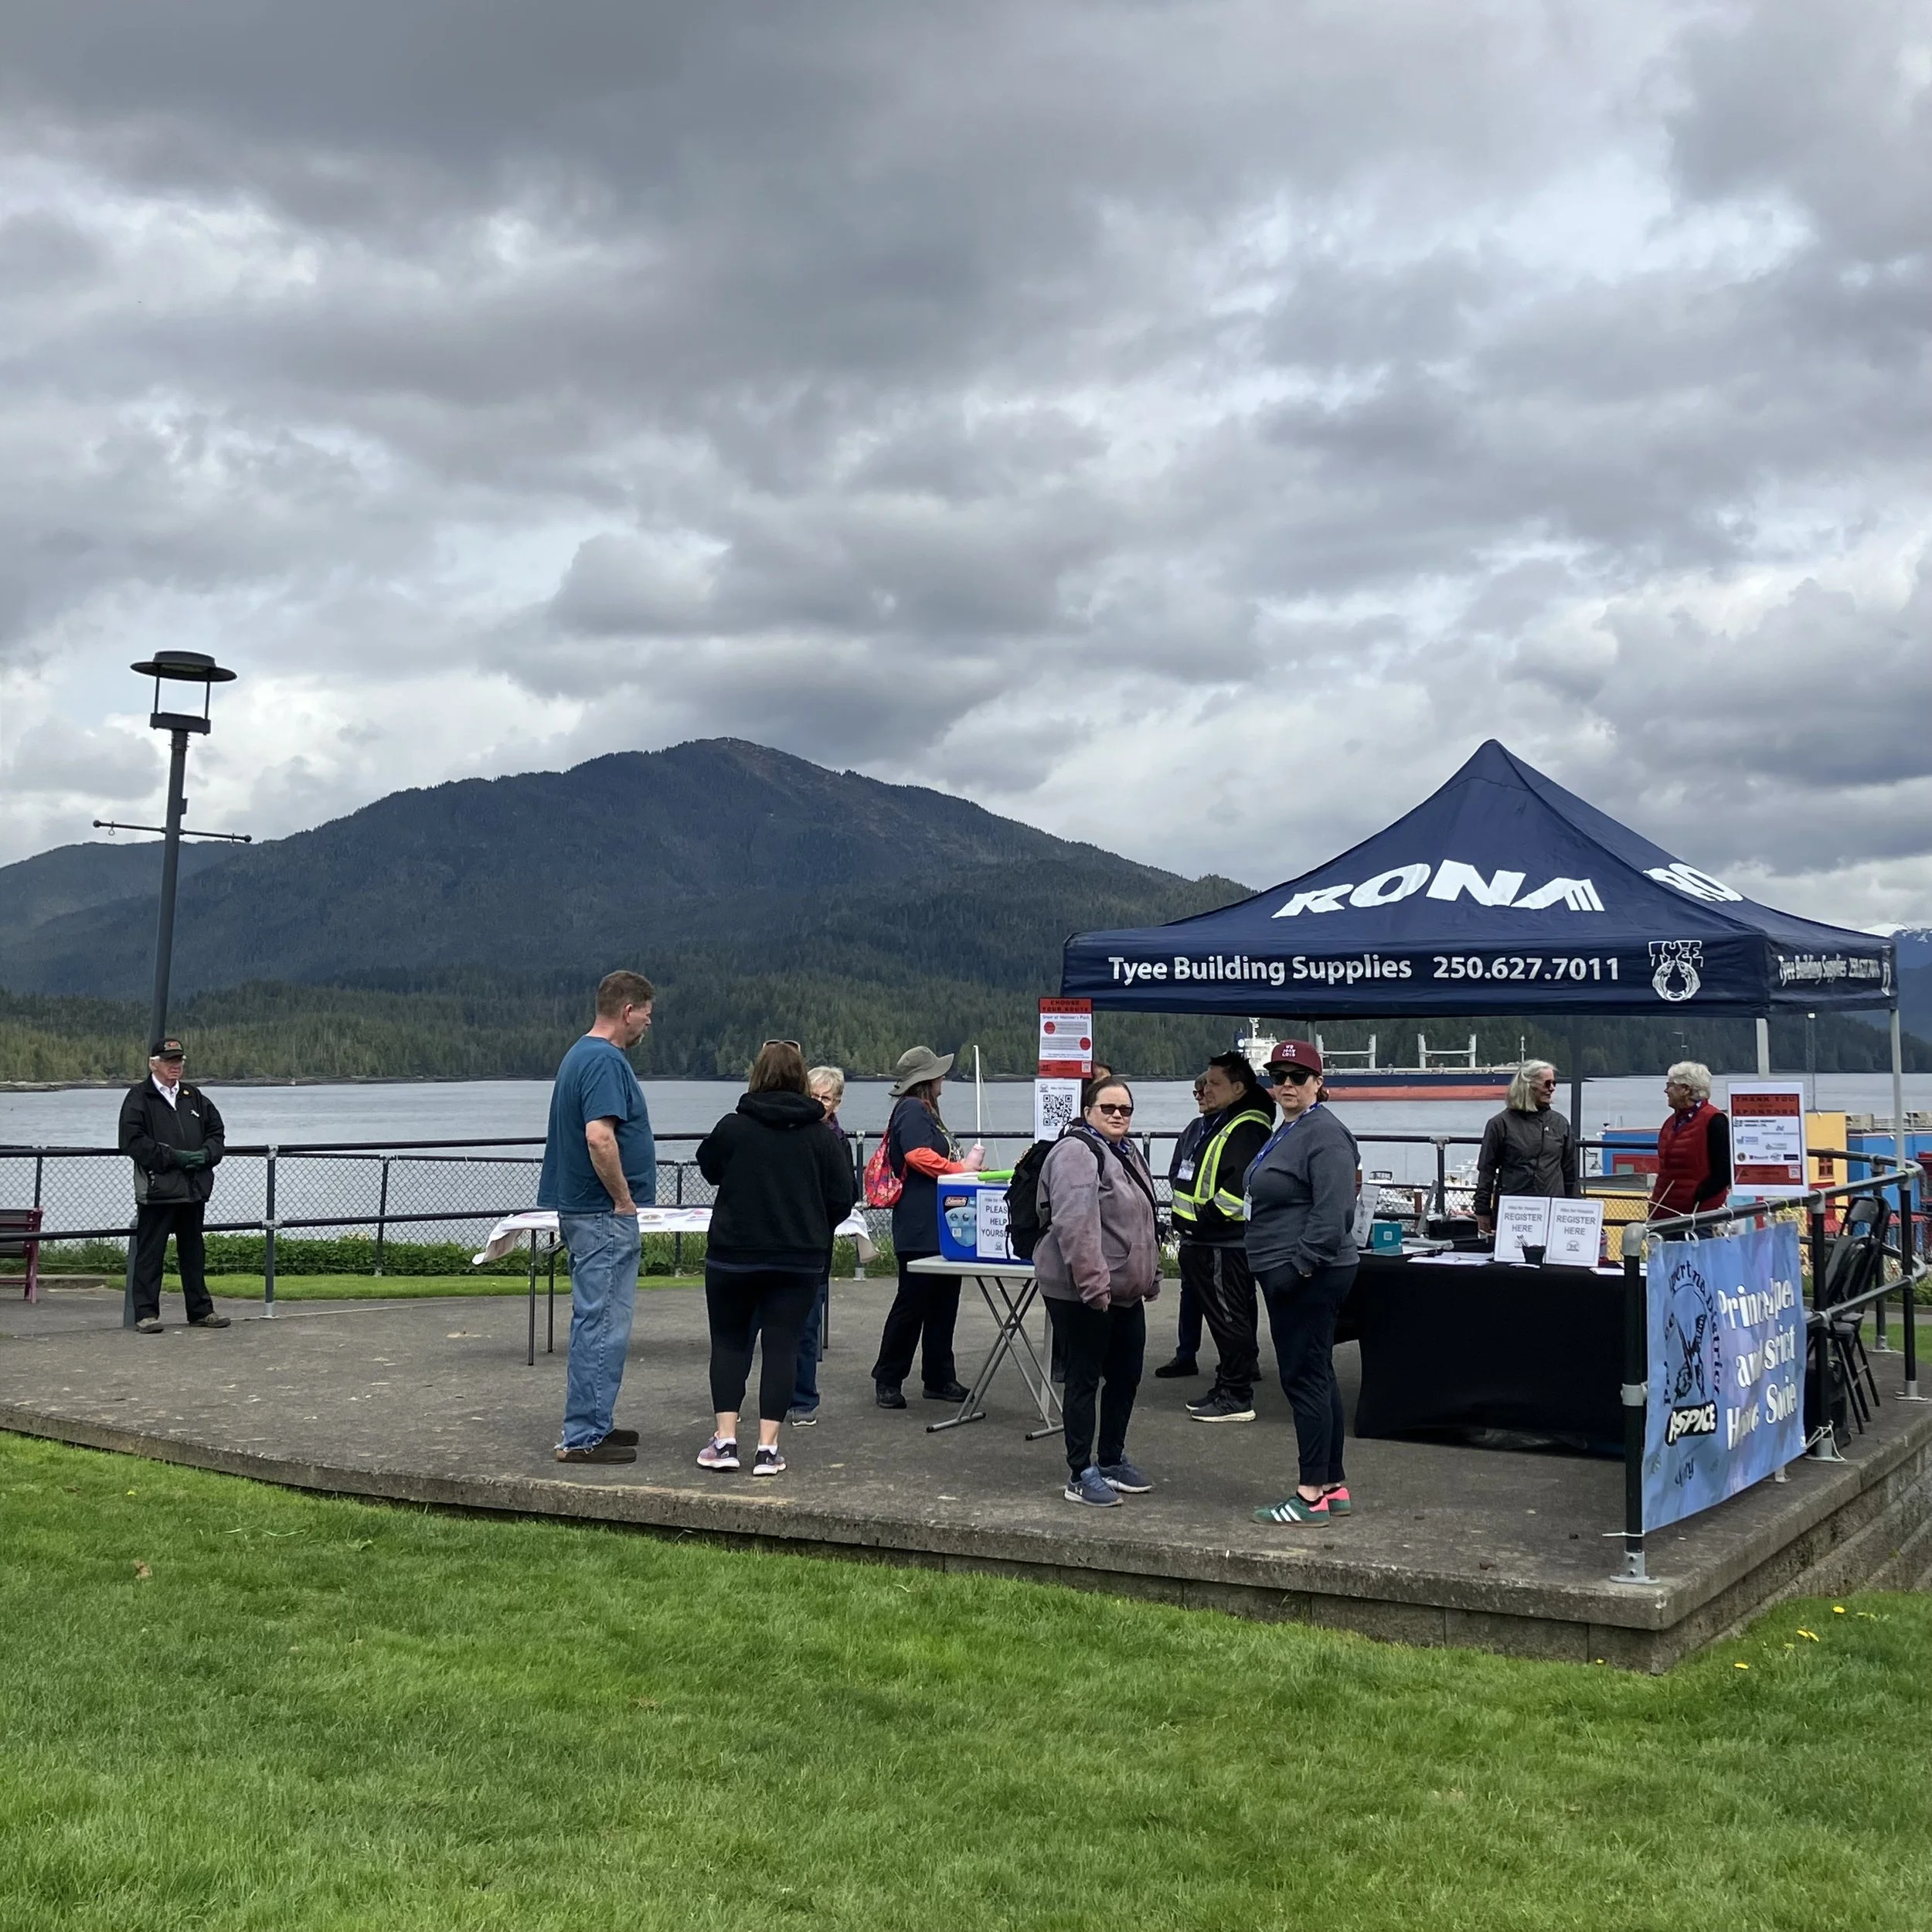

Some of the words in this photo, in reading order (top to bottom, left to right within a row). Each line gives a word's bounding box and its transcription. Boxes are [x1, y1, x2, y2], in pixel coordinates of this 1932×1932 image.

[1642, 862, 1743, 903] RO
[1271, 859, 1605, 919] RONA
[1108, 957, 1168, 986] Tyee
[1174, 955, 1285, 986] Building
[1292, 954, 1413, 985] Supplies
[1433, 956, 1618, 981] 250.627.7011
[985, 1205, 1008, 1214] PLEAS
[989, 1218, 1008, 1226] HELP
[1504, 1213, 1543, 1222] REGISTER
[1556, 1216, 1596, 1225] REGISTER
[1512, 1224, 1533, 1233] HERE
[1563, 1226, 1586, 1236] HERE
[981, 1229, 1008, 1238] YOURS
